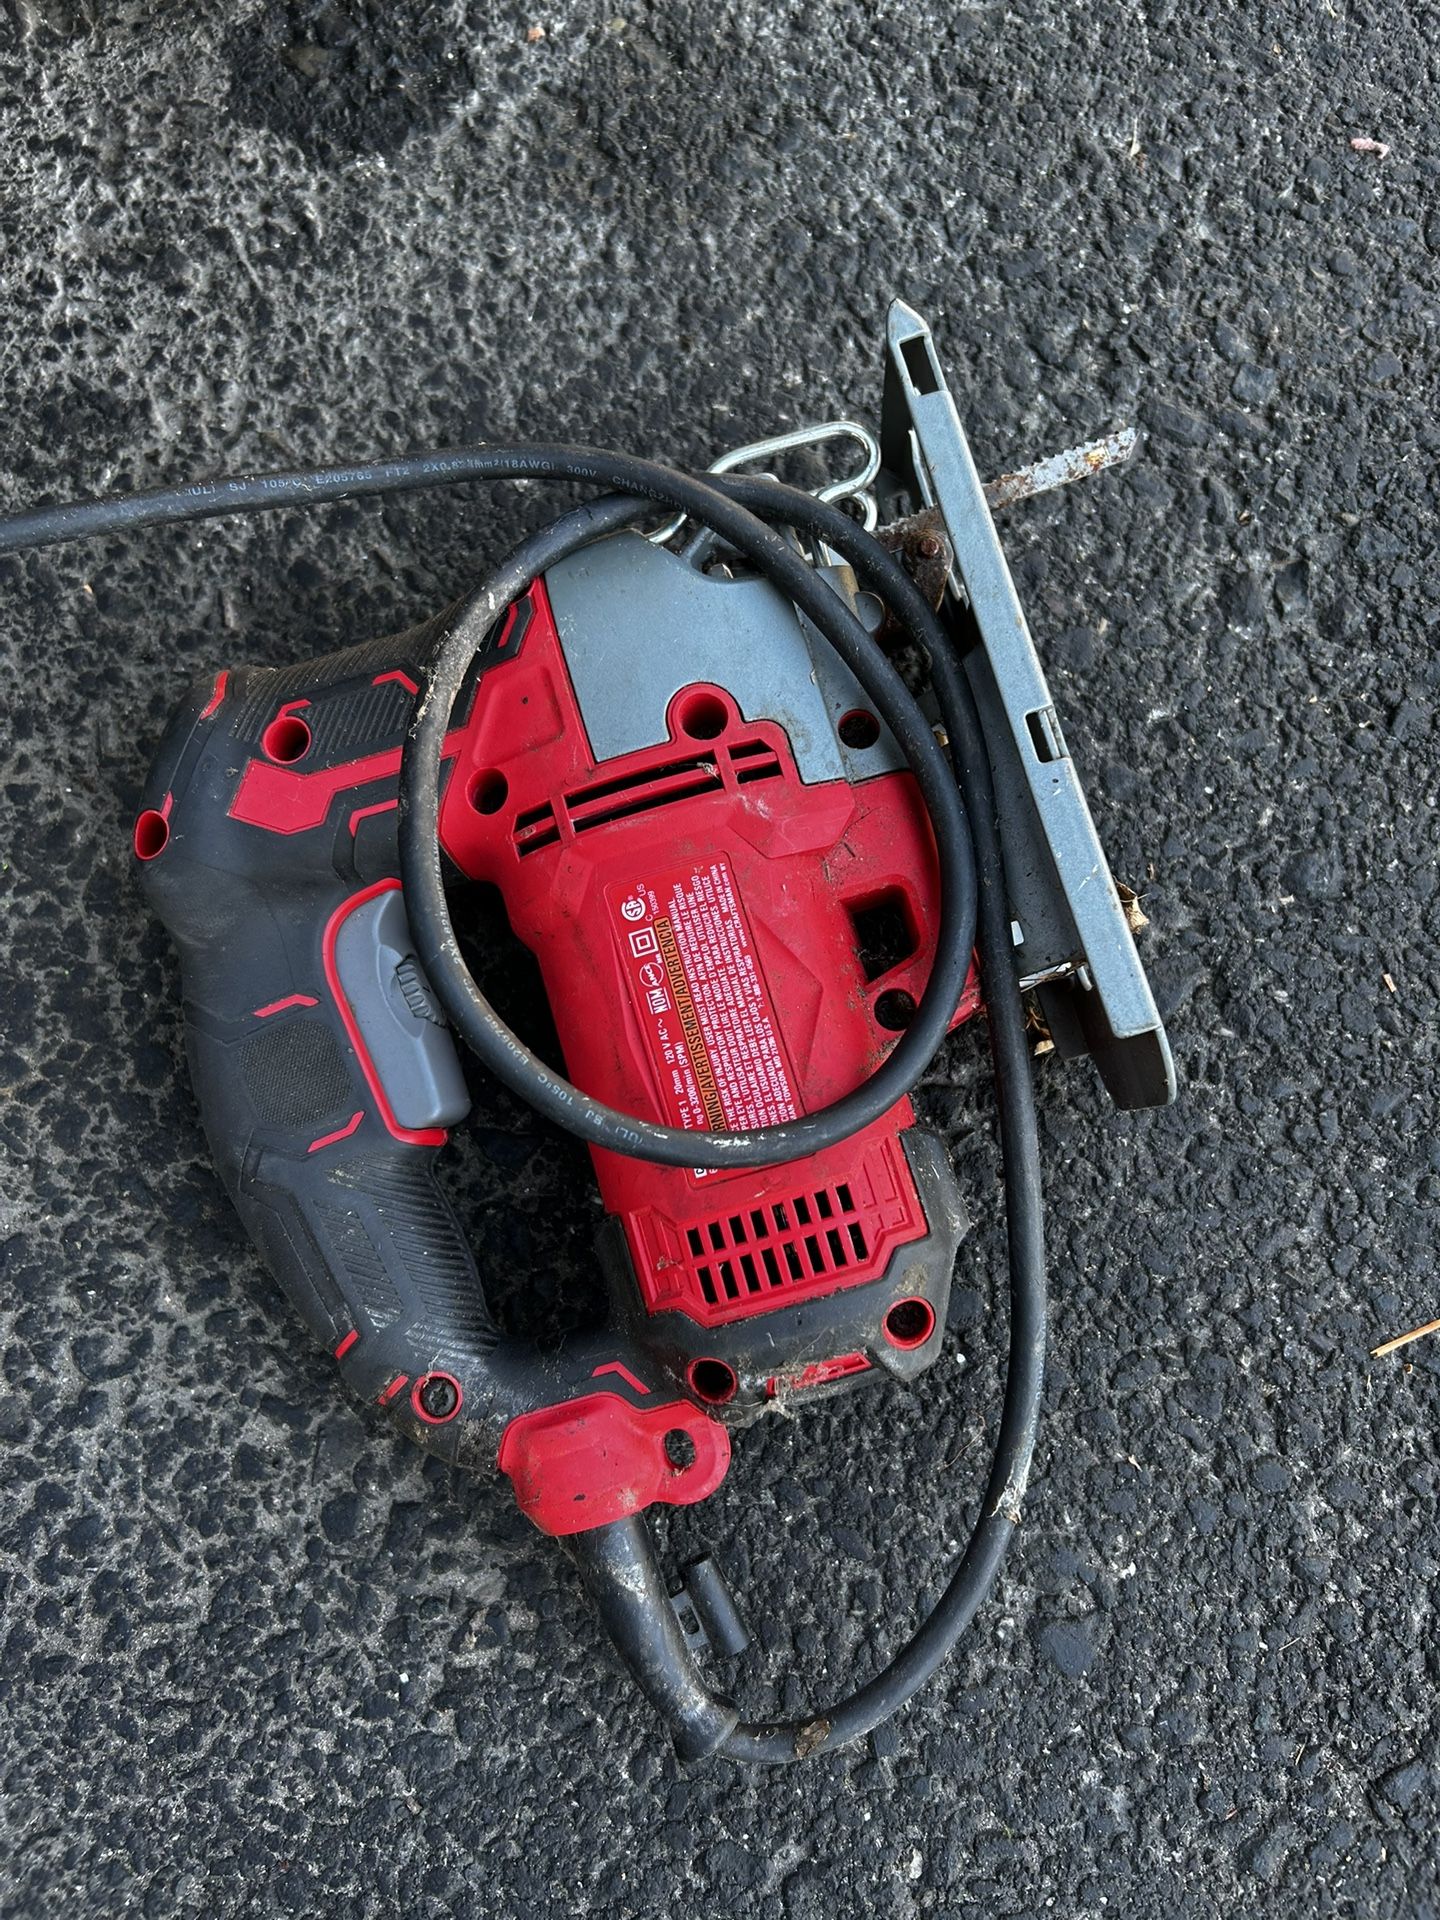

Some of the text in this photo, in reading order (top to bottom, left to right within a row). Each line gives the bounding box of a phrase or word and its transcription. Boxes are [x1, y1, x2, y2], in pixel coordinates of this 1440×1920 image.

[229, 482, 247, 492] SJ
[385, 467, 411, 478] FT2
[566, 464, 599, 479] 300V
[636, 883, 646, 897] US
[672, 883, 687, 911] RISQUE
[690, 875, 705, 903] RIESGO
[701, 875, 716, 903] UTILICE
[709, 864, 729, 913] MADE IN CHINA
[647, 890, 659, 915] 150399
[685, 891, 697, 909] UNE
[699, 902, 708, 912] EL
[680, 910, 690, 920] LE
[690, 908, 707, 941] UTILISER
[683, 920, 699, 952] REDUIRE
[701, 911, 717, 944] REDUCIR
[676, 932, 697, 982] INSTRUCTION
[692, 951, 703, 963] DE
[710, 943, 723, 966] PARA
[643, 962, 660, 987] ANCE
[695, 962, 708, 981] AFIN
[726, 964, 737, 975] DE
[690, 982, 703, 1003] READ
[710, 978, 724, 1002] MODE
[730, 975, 746, 1009] MANUAL
[740, 976, 753, 996] VIAS
[649, 987, 668, 1014] NOM
[716, 1001, 727, 1012] LE
[696, 1003, 710, 1026] MUST
[719, 1011, 731, 1029] LIRE
[739, 1008, 749, 1019] EL
[748, 1001, 761, 1023] OJOS
[656, 919, 727, 1134] RNING/AVERTISSEMENT/ADVERTENCIA
[658, 1028, 669, 1040] AC
[702, 1025, 716, 1046] USER
[728, 1007, 751, 1060] RESPIRATOIRE
[742, 1018, 755, 1037] LEER
[754, 1023, 766, 1038] LOS
[724, 1029, 737, 1047] DOIT
[747, 1037, 760, 1058] DEBE
[664, 1049, 675, 1064] 120
[674, 1041, 690, 1068] (SPM)
[714, 1031, 736, 1082] RESPIRATORY
[758, 1038, 772, 1060] PARA
[743, 1061, 754, 1071] ET
[772, 1055, 783, 1069] MD
[671, 1069, 684, 1095] 20mm
[717, 1077, 727, 1088] OF
[753, 1058, 770, 1093] USUARIO
[765, 1059, 784, 1102] ADECUADA
[683, 1068, 702, 1114] 0-3200/min
[720, 1087, 733, 1107] RISK
[729, 1081, 741, 1099] AND
[746, 1070, 764, 1108] OCULAIRE
[763, 1092, 773, 1103] EL
[725, 1106, 736, 1123] THE
[734, 1099, 745, 1115] EYE
[679, 1106, 693, 1130] TYPE
[738, 1114, 750, 1131] PER
